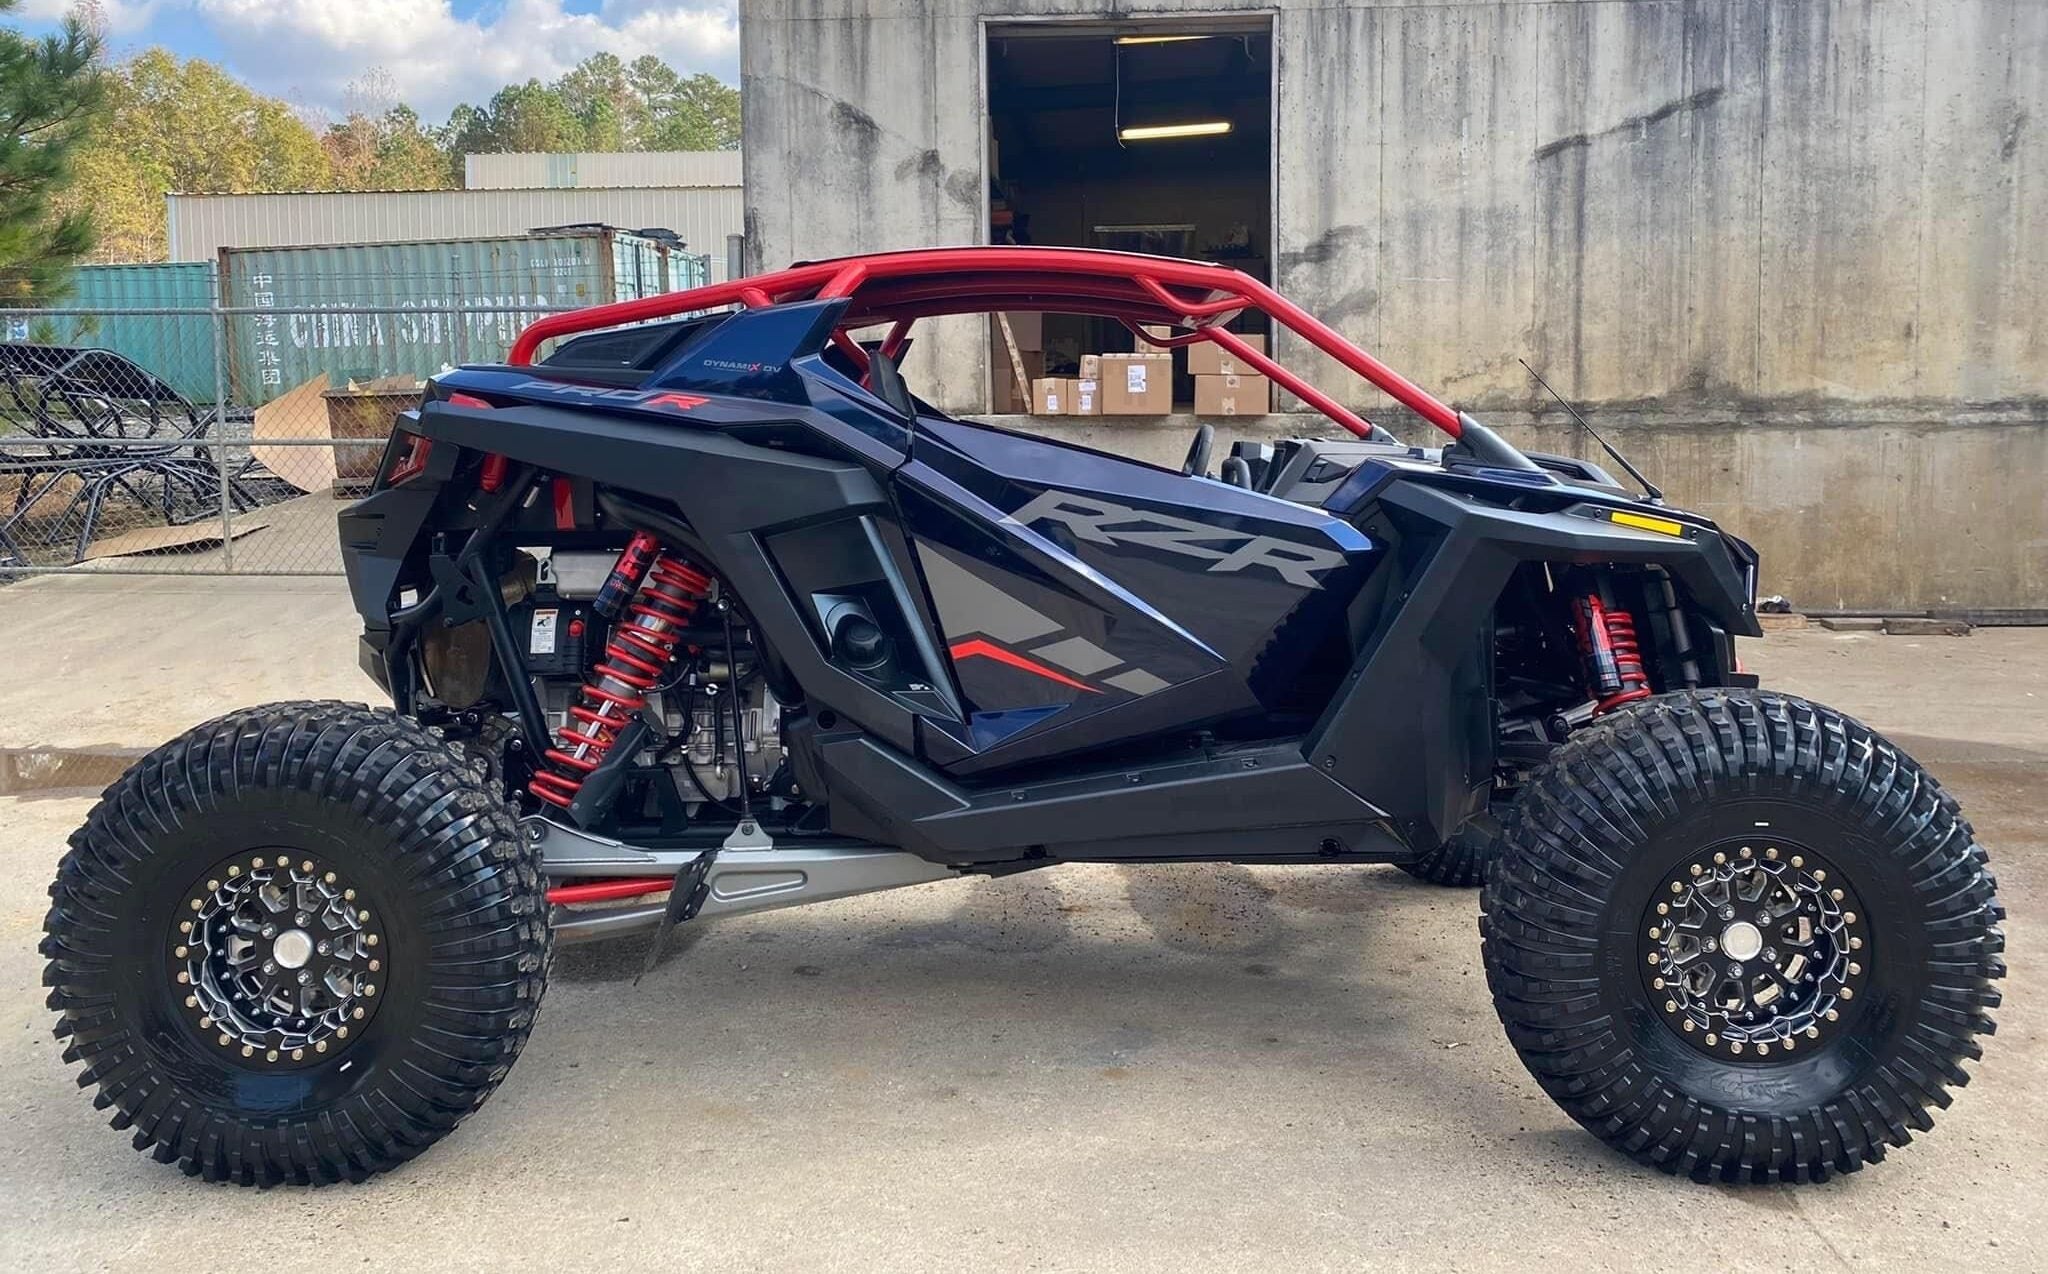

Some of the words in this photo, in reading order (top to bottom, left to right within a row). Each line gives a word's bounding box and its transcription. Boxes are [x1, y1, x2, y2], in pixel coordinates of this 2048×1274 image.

[289, 302, 385, 348] CHINA
[703, 358, 762, 373] DYNAMIX
[763, 365, 782, 373] DV
[508, 380, 656, 402] PRO
[644, 393, 711, 410] R
[998, 489, 1349, 591] RZR
